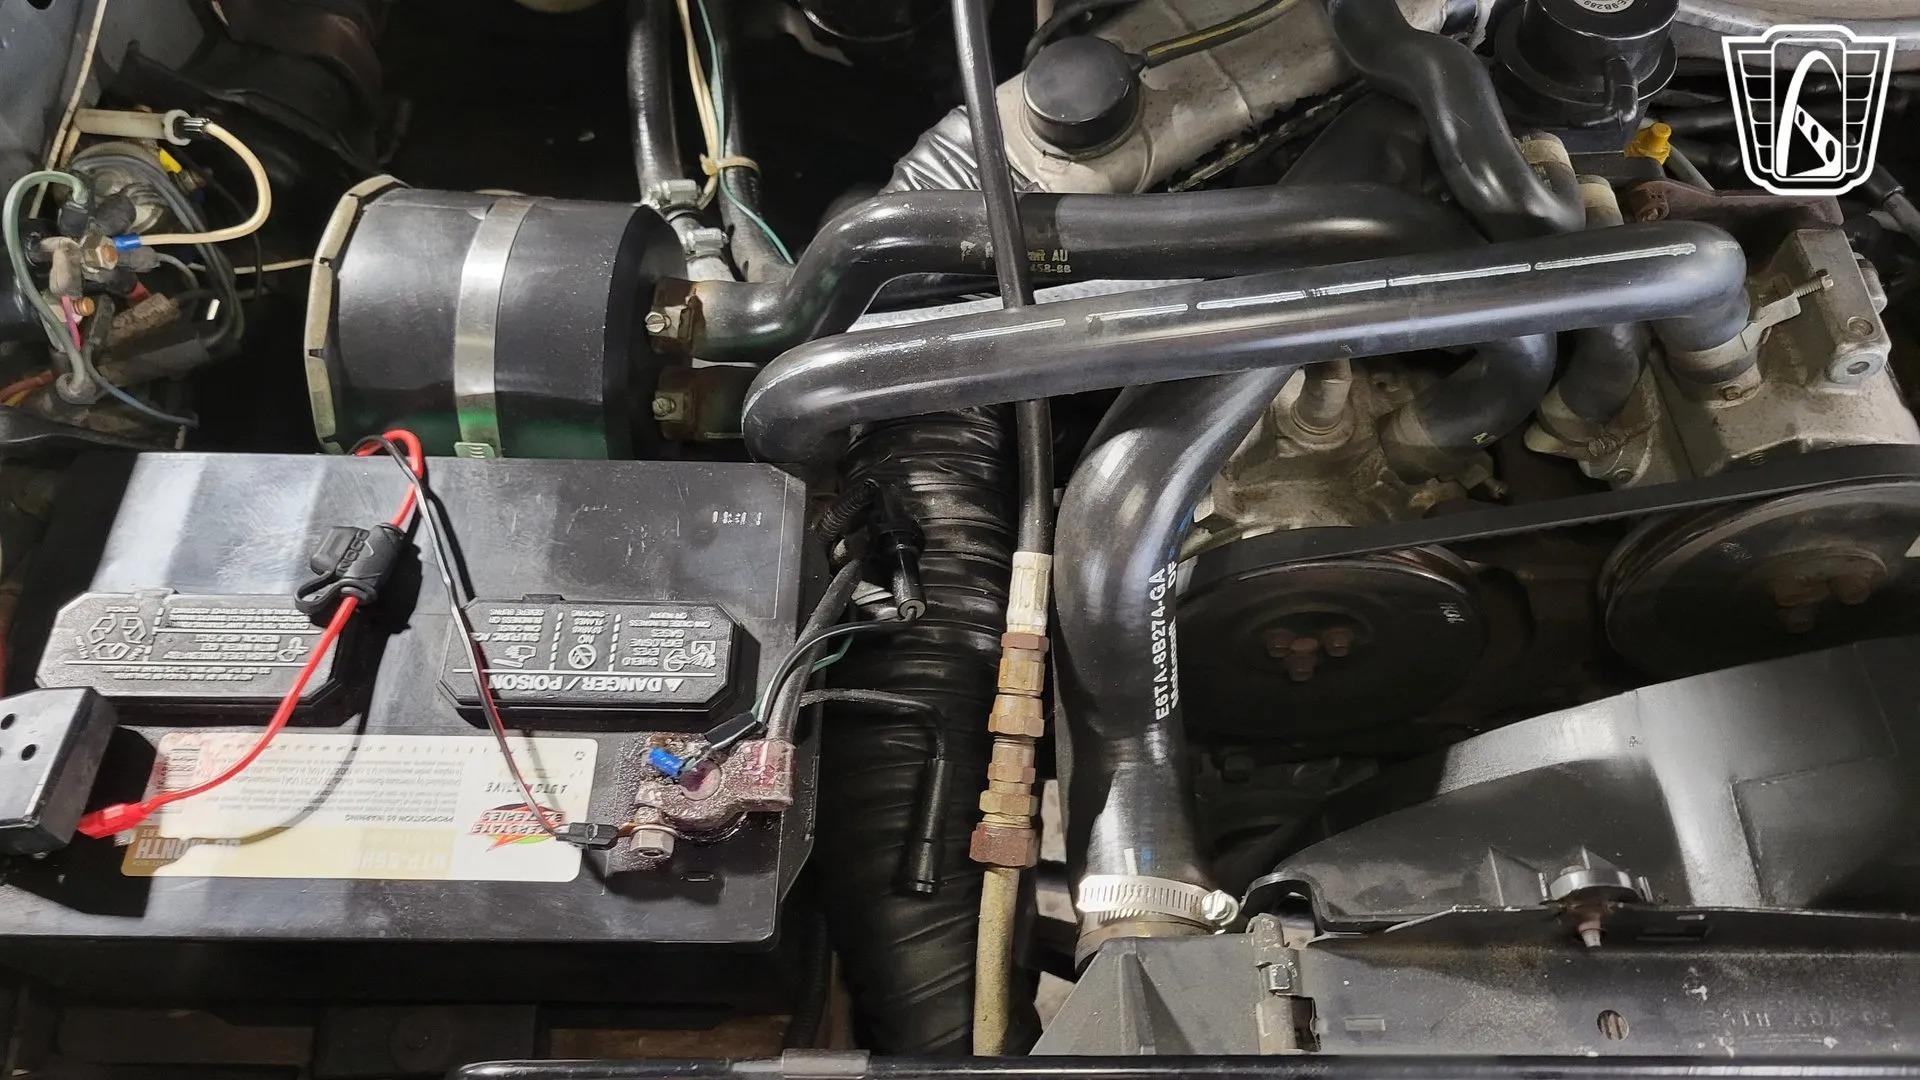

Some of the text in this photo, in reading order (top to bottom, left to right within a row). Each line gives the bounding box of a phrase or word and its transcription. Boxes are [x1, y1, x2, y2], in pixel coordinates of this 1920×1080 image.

[577, 634, 595, 644] NO
[489, 674, 564, 689] POISON
[580, 676, 662, 692] DANGER
[480, 811, 563, 823] BATERIES
